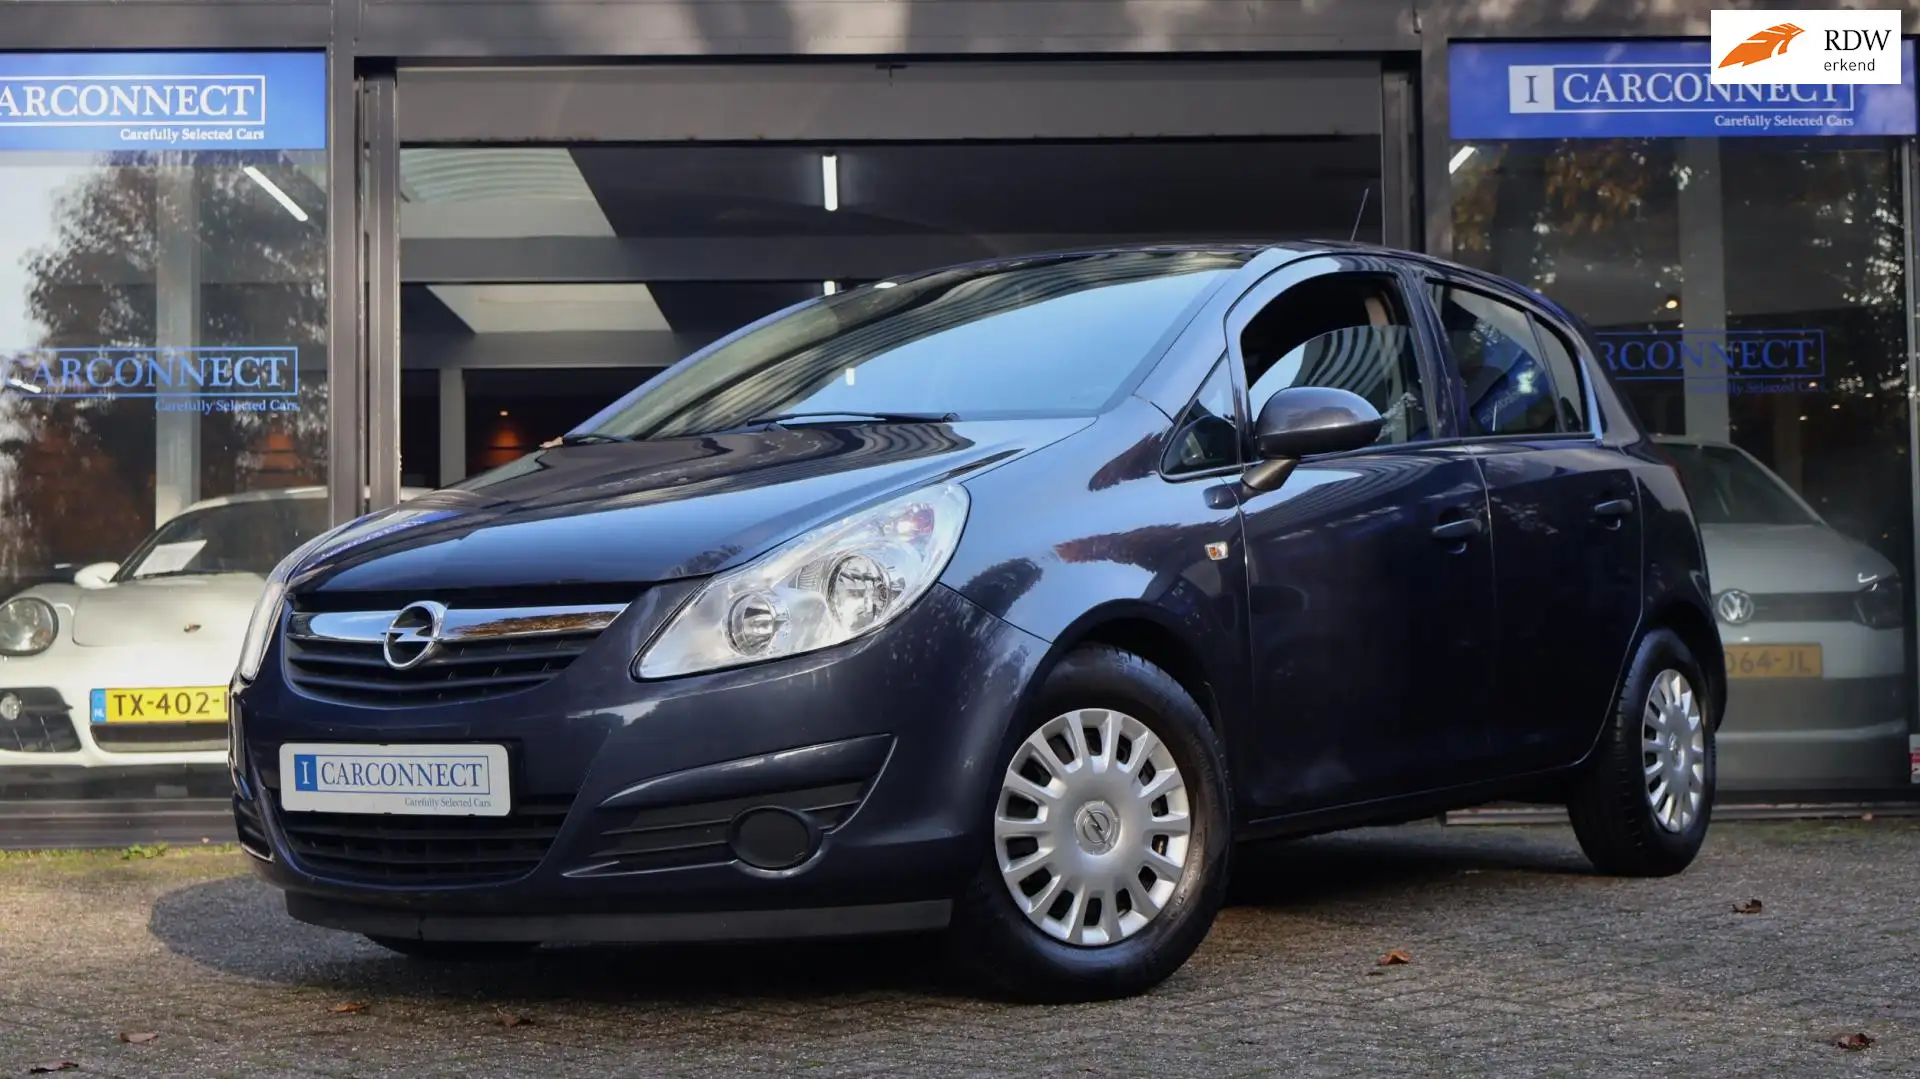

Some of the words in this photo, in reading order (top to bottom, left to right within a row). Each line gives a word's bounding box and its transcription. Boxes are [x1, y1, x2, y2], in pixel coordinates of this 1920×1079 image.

[1714, 115, 1772, 130] Carefully
[1774, 115, 1824, 127] Selected
[1826, 115, 1855, 127] Cars
[120, 128, 179, 144] Carefully
[181, 128, 233, 141] Selected
[236, 128, 265, 141] Cars
[216, 399, 267, 412] Selected
[113, 691, 228, 716] TX-402-
[321, 761, 483, 787] CARCONNECT
[404, 797, 439, 811] Carefully
[440, 798, 472, 807] Selected
[473, 798, 492, 808] Cars
